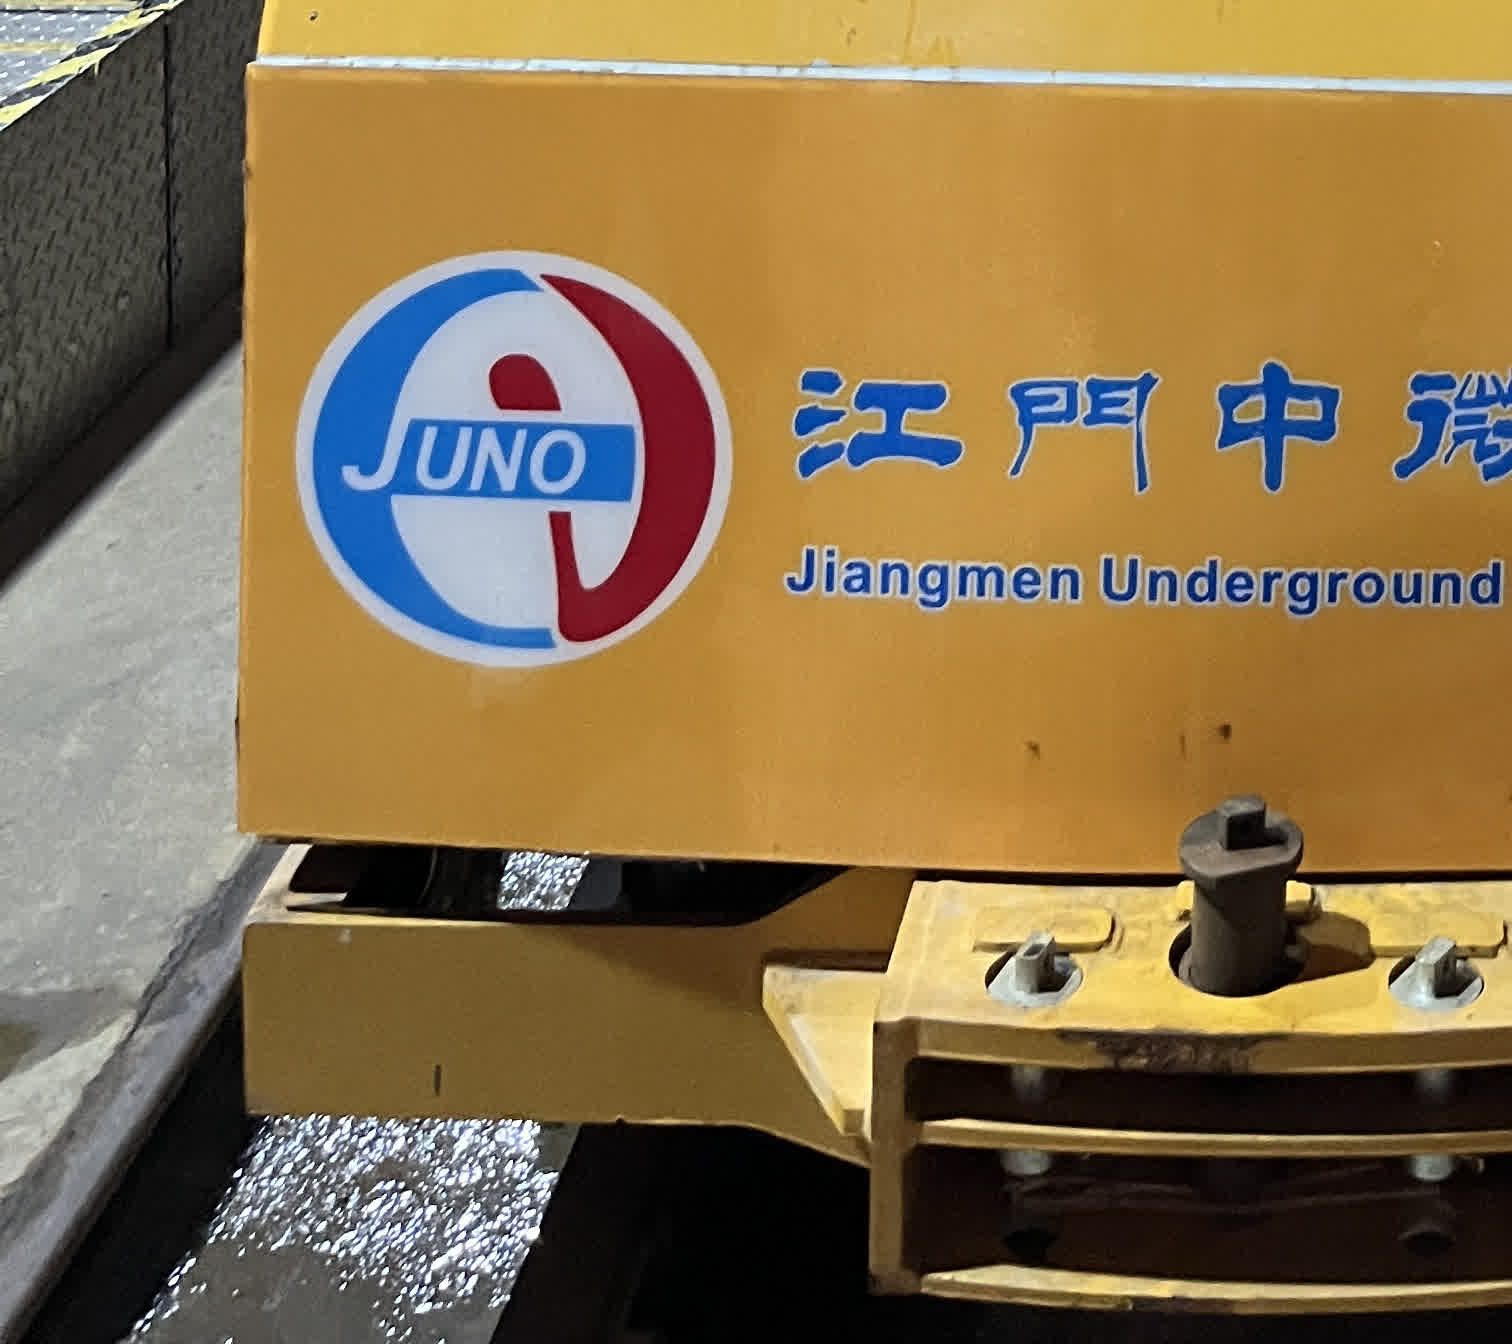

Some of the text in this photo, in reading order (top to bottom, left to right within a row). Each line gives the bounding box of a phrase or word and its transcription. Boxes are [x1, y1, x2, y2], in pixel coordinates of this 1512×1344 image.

[341, 424, 587, 494] JUNO
[786, 549, 1080, 609] Jiangmen
[1102, 558, 1502, 616] Underground
